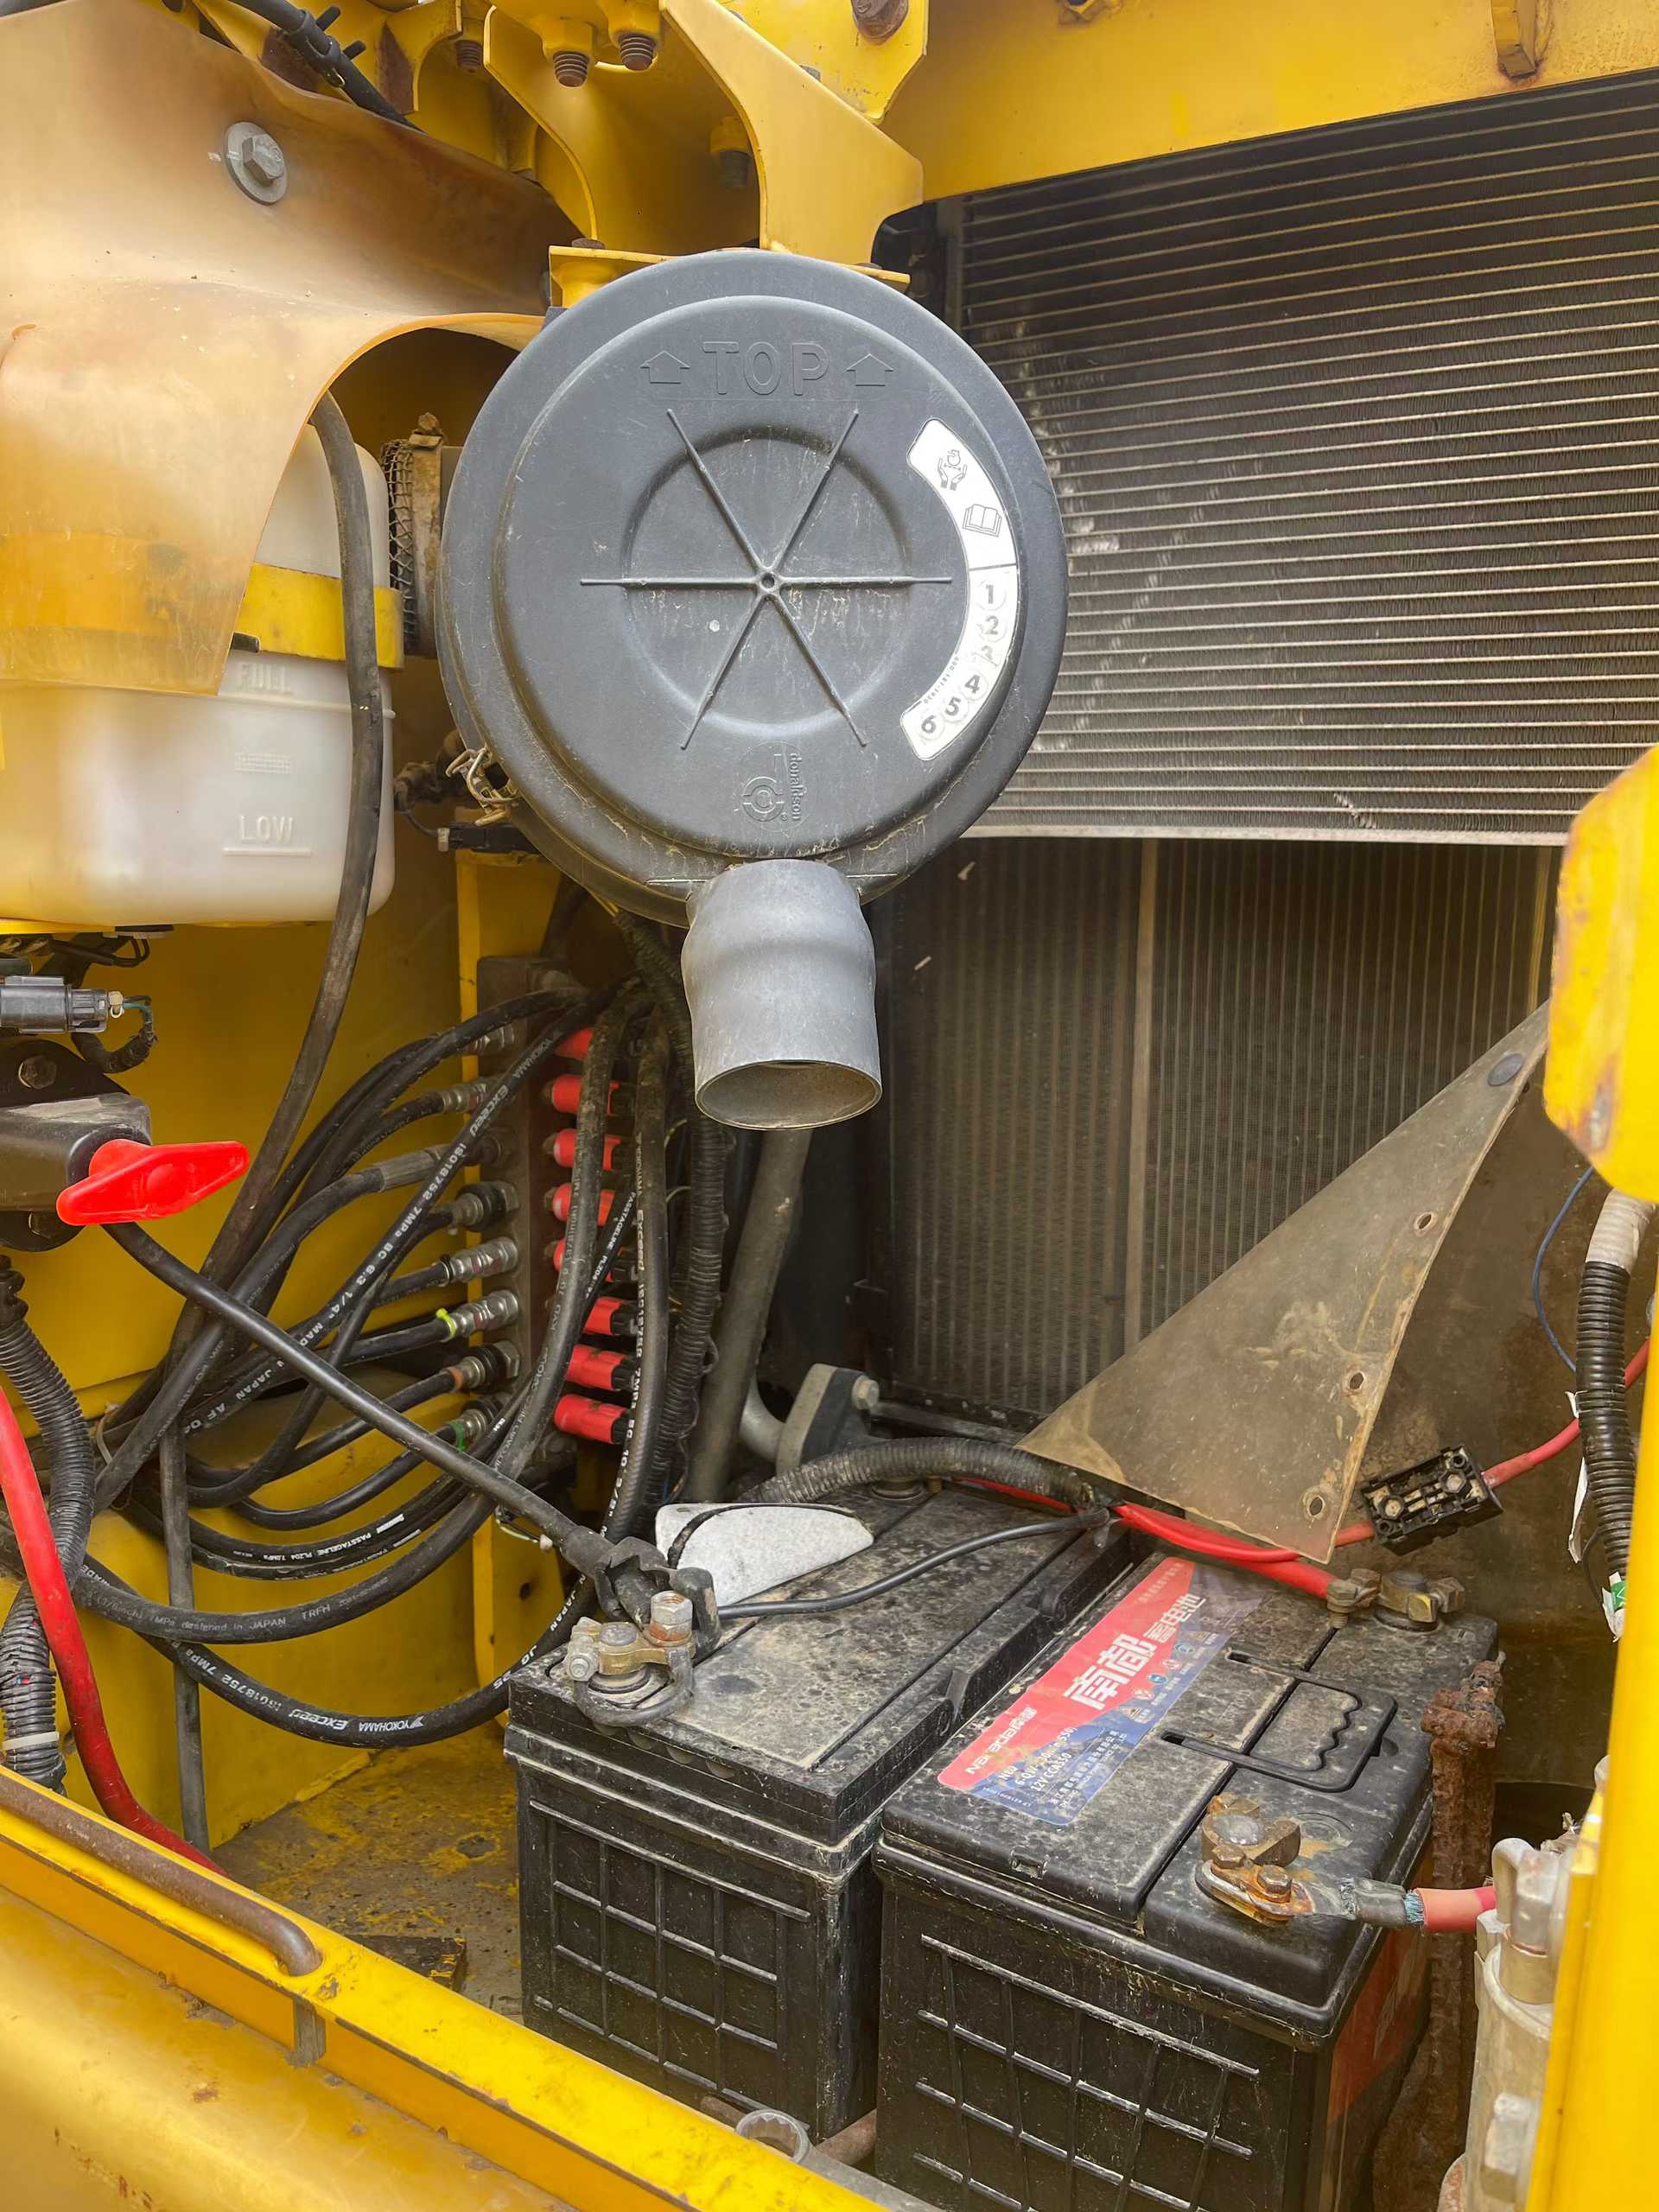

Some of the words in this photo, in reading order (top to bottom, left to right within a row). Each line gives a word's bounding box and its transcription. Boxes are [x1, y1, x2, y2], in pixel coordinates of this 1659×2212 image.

[702, 340, 830, 397] TOP
[985, 583, 995, 605] 1
[984, 614, 1000, 636] 2
[964, 674, 982, 695] 4
[944, 696, 962, 716] 5
[920, 714, 937, 734] 6
[240, 814, 294, 844] LOW
[469, 1084, 509, 1137] Exceed
[422, 1142, 467, 1201] ISO18752
[394, 1205, 423, 1237] 7MPa
[378, 1242, 394, 1260] BC
[299, 1322, 324, 1346] MAD
[235, 1368, 273, 1401] JAPAN
[249, 1617, 288, 1630] JAPAN
[550, 1589, 577, 1632] JAPAN
[185, 1648, 217, 1676] 7MPa
[1062, 1632, 1158, 1712] 南都
[1142, 1592, 1207, 1644] 蓄电池
[220, 1673, 283, 1713] ISO18752
[288, 1707, 351, 1731] Exceed
[358, 1719, 412, 1732] YOKOHAMA
